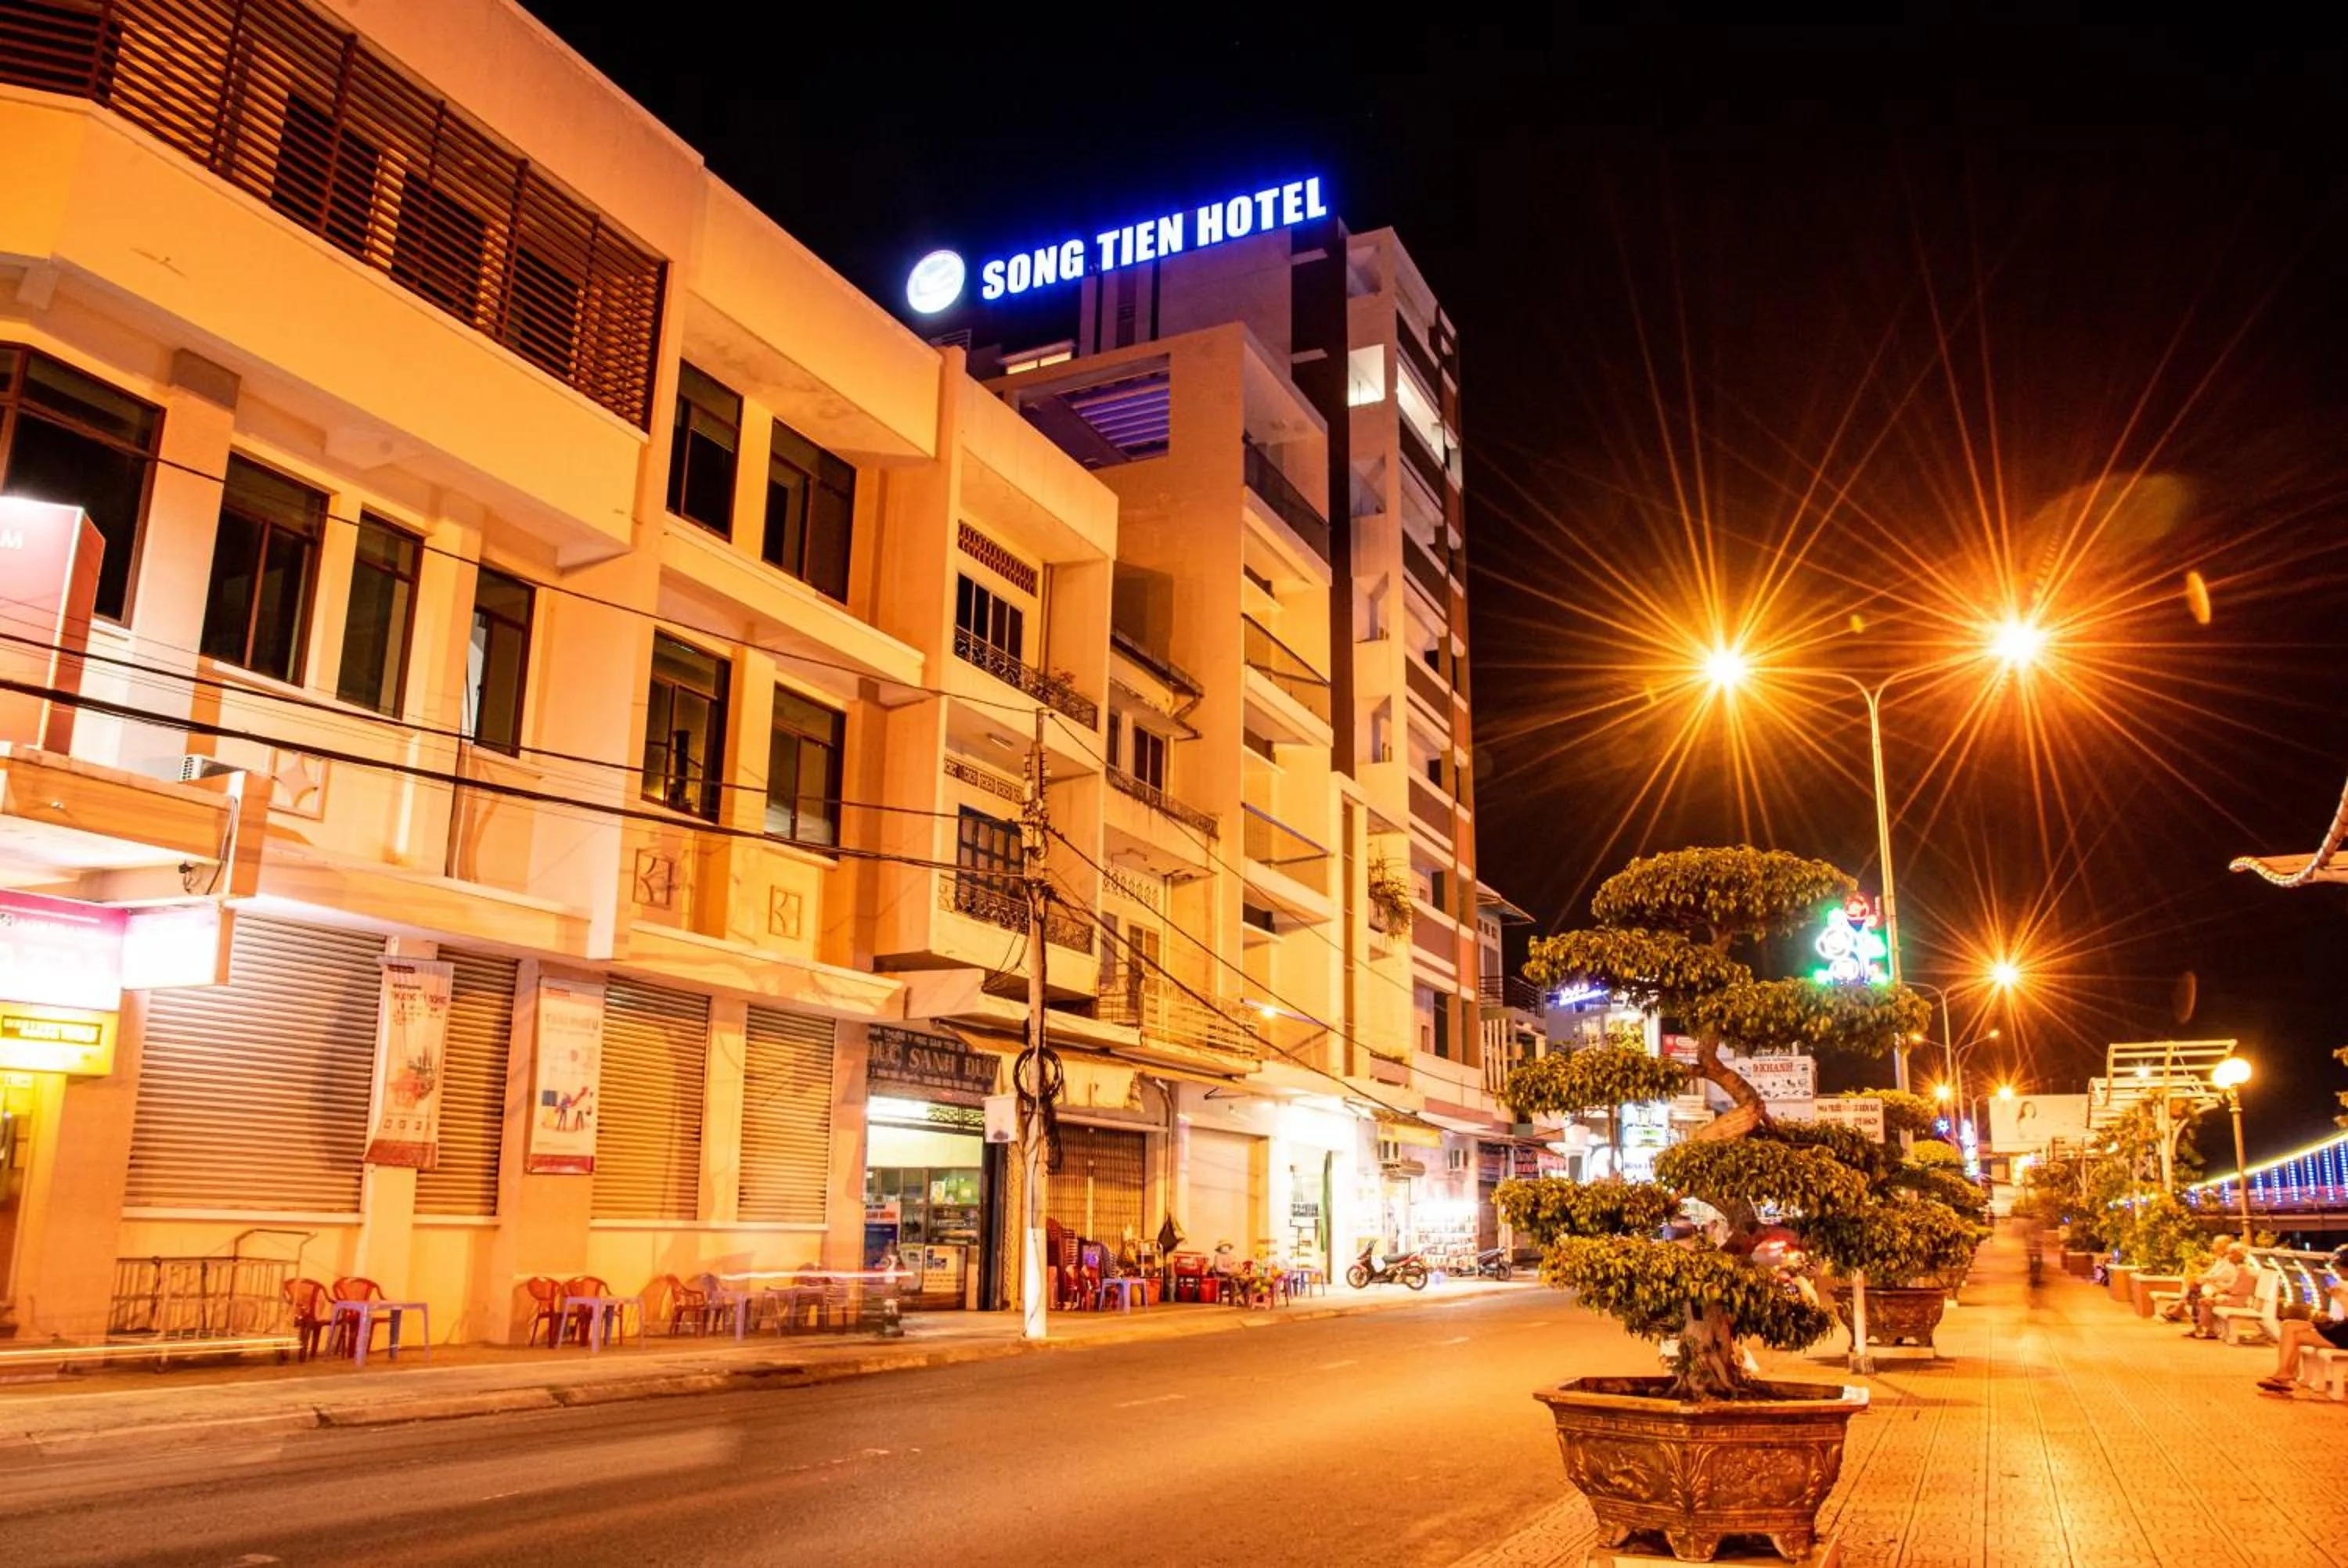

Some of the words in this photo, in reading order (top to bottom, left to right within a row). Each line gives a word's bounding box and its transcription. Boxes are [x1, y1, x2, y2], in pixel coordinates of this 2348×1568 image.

[982, 239, 1085, 300] SONG
[1097, 213, 1183, 271] TIEN
[1197, 177, 1327, 246] HOTEL
[909, 1047, 956, 1073] SANH
